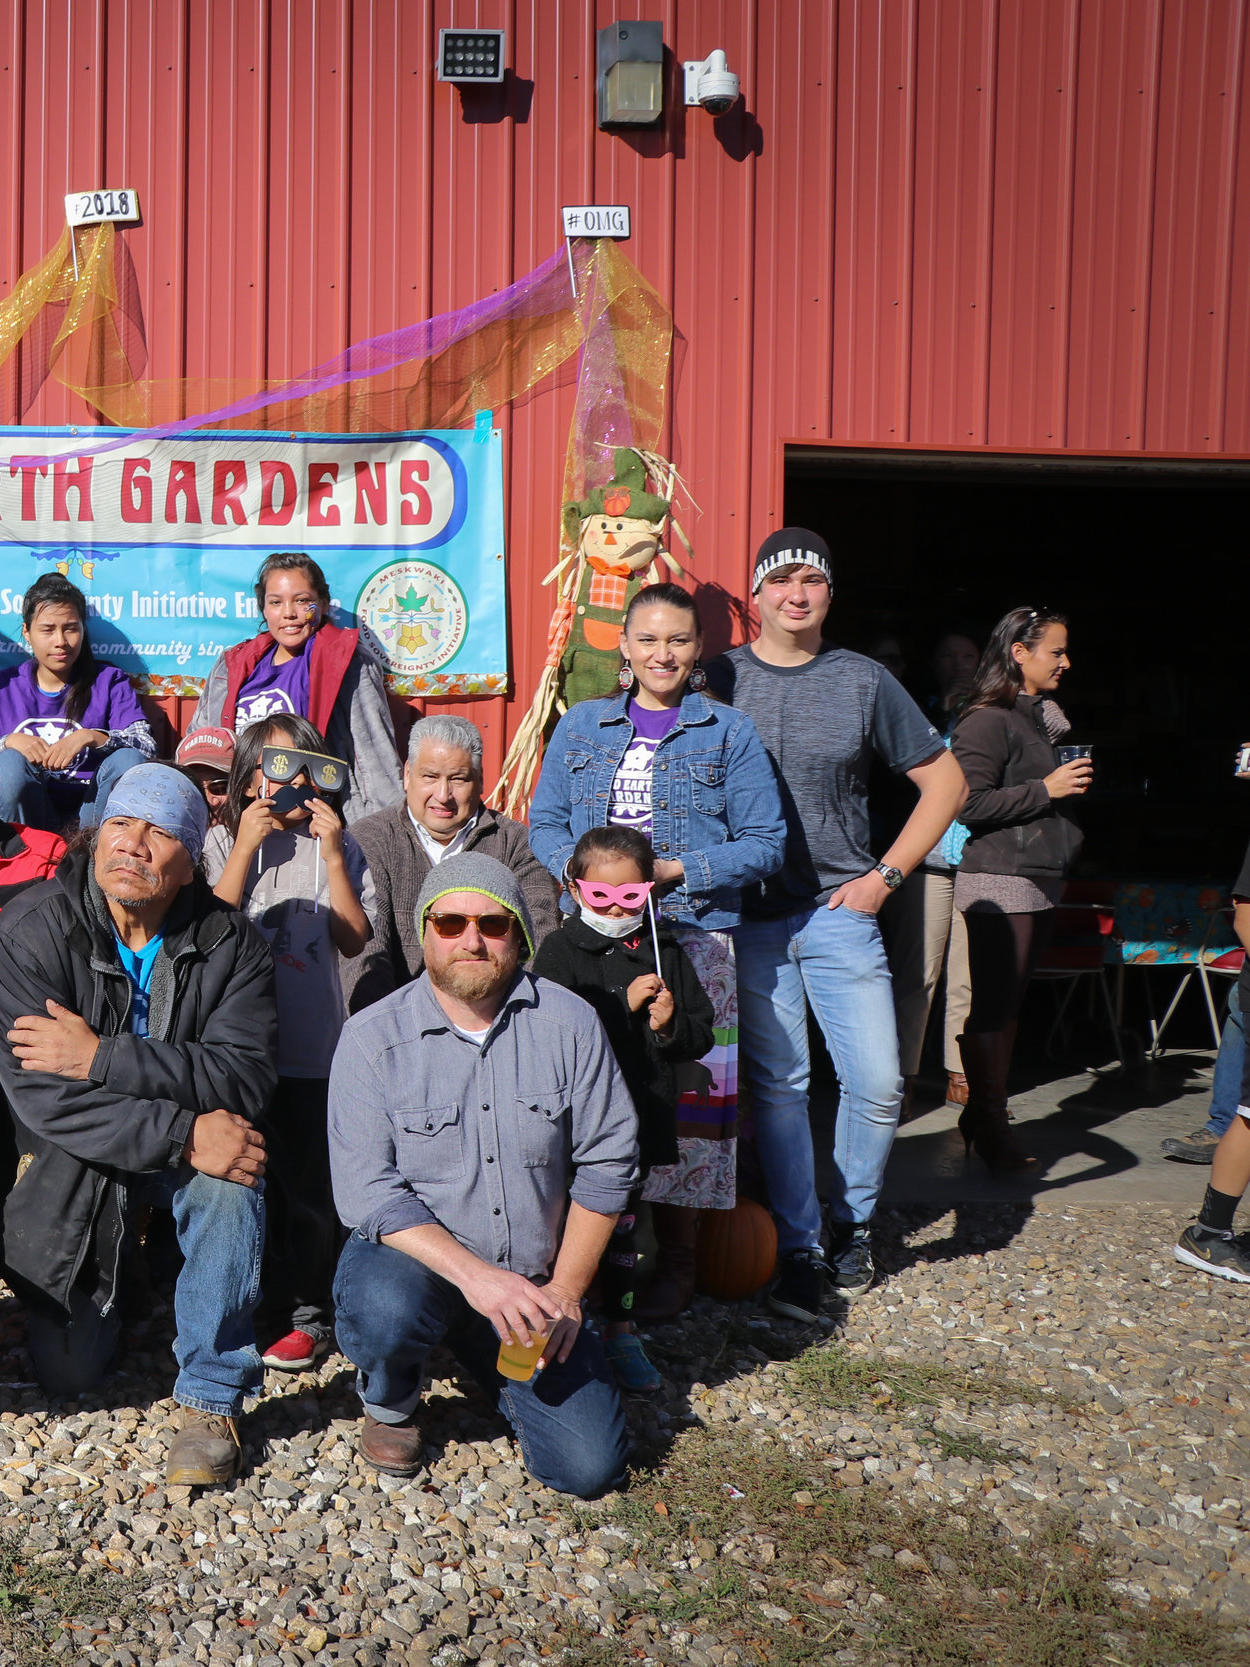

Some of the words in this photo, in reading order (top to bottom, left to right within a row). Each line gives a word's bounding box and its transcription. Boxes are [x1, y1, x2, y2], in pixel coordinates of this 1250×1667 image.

[81, 192, 129, 218] 2018
[121, 458, 432, 526] GARDENS
[379, 566, 445, 584] MESKWAKI
[132, 591, 227, 618] Initiative
[361, 609, 371, 640] FOOD
[369, 642, 436, 671] SOVEREIGNTY
[437, 607, 462, 661] INITIATIVE
[91, 640, 192, 665] community
[198, 641, 233, 656] sin
[184, 735, 223, 751] WARRIORS
[623, 779, 652, 792] EART
